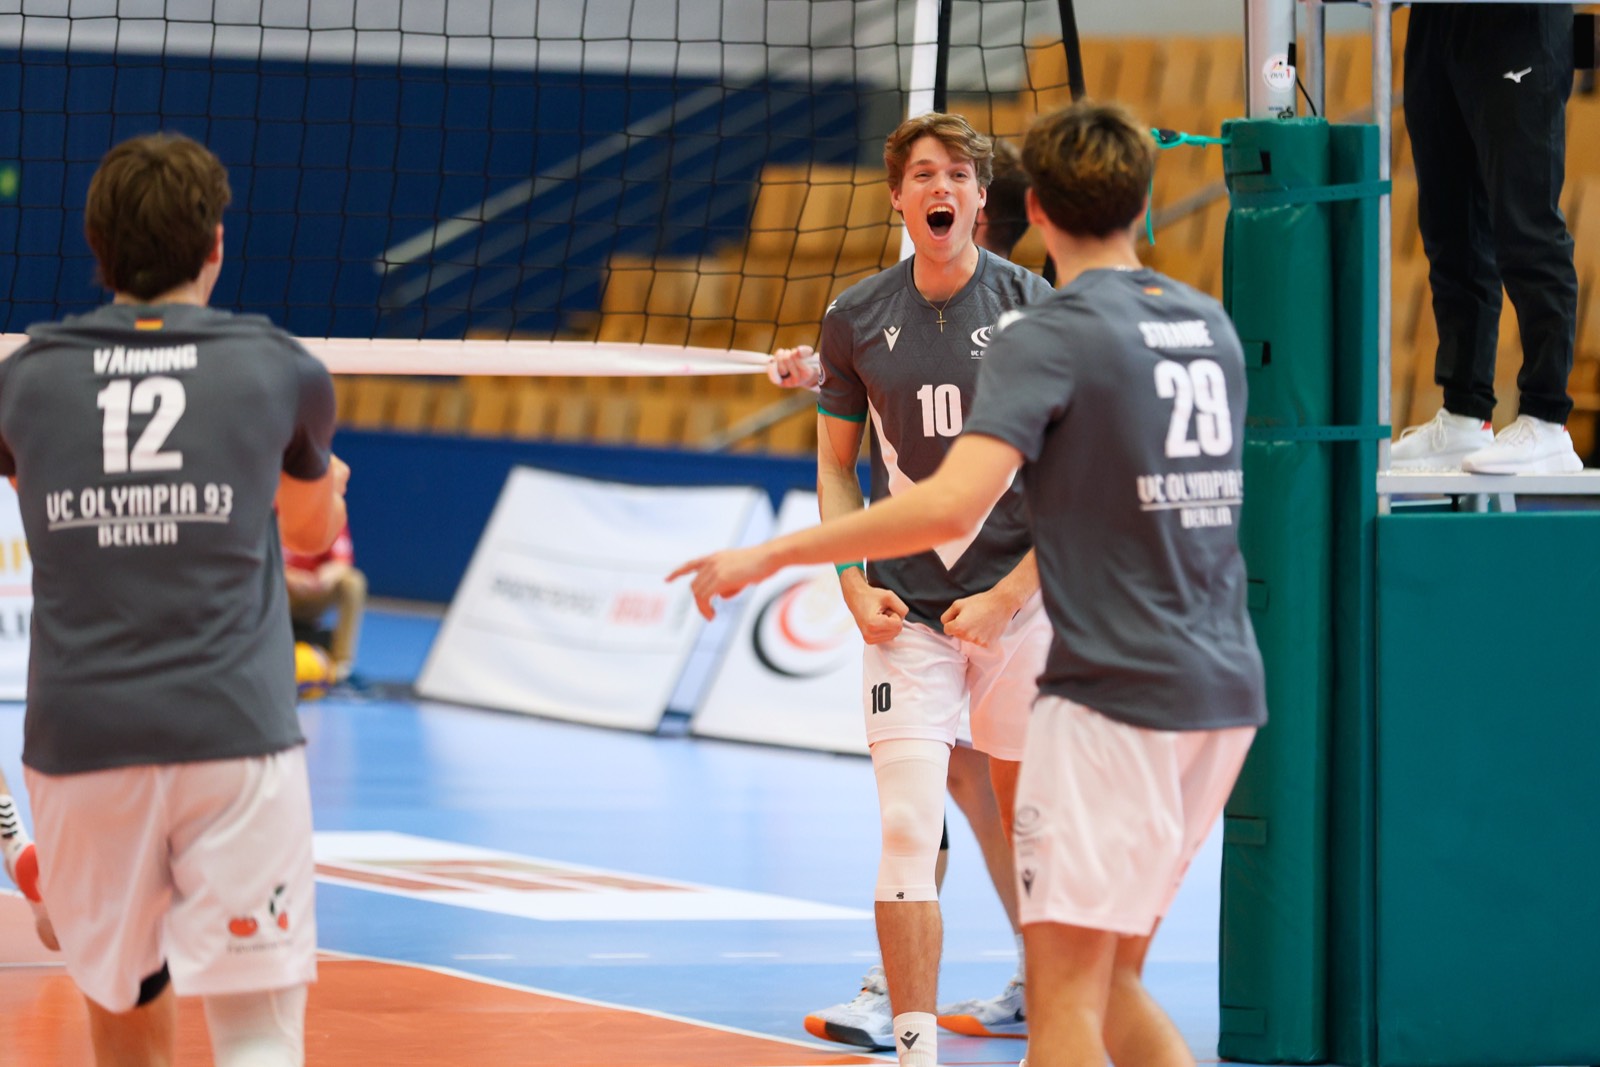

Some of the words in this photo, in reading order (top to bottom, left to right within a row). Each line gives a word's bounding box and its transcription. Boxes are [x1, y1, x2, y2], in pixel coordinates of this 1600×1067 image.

[97, 375, 186, 475] 12
[916, 383, 963, 438] 10
[1154, 358, 1233, 459] 29
[46, 490, 74, 522] UC
[80, 483, 198, 518] OLYMPIA
[204, 482, 234, 515] 93
[1137, 474, 1166, 503] UC
[98, 521, 178, 547] BERLIN
[1181, 506, 1232, 529] BERLIN
[871, 682, 892, 715] 10
